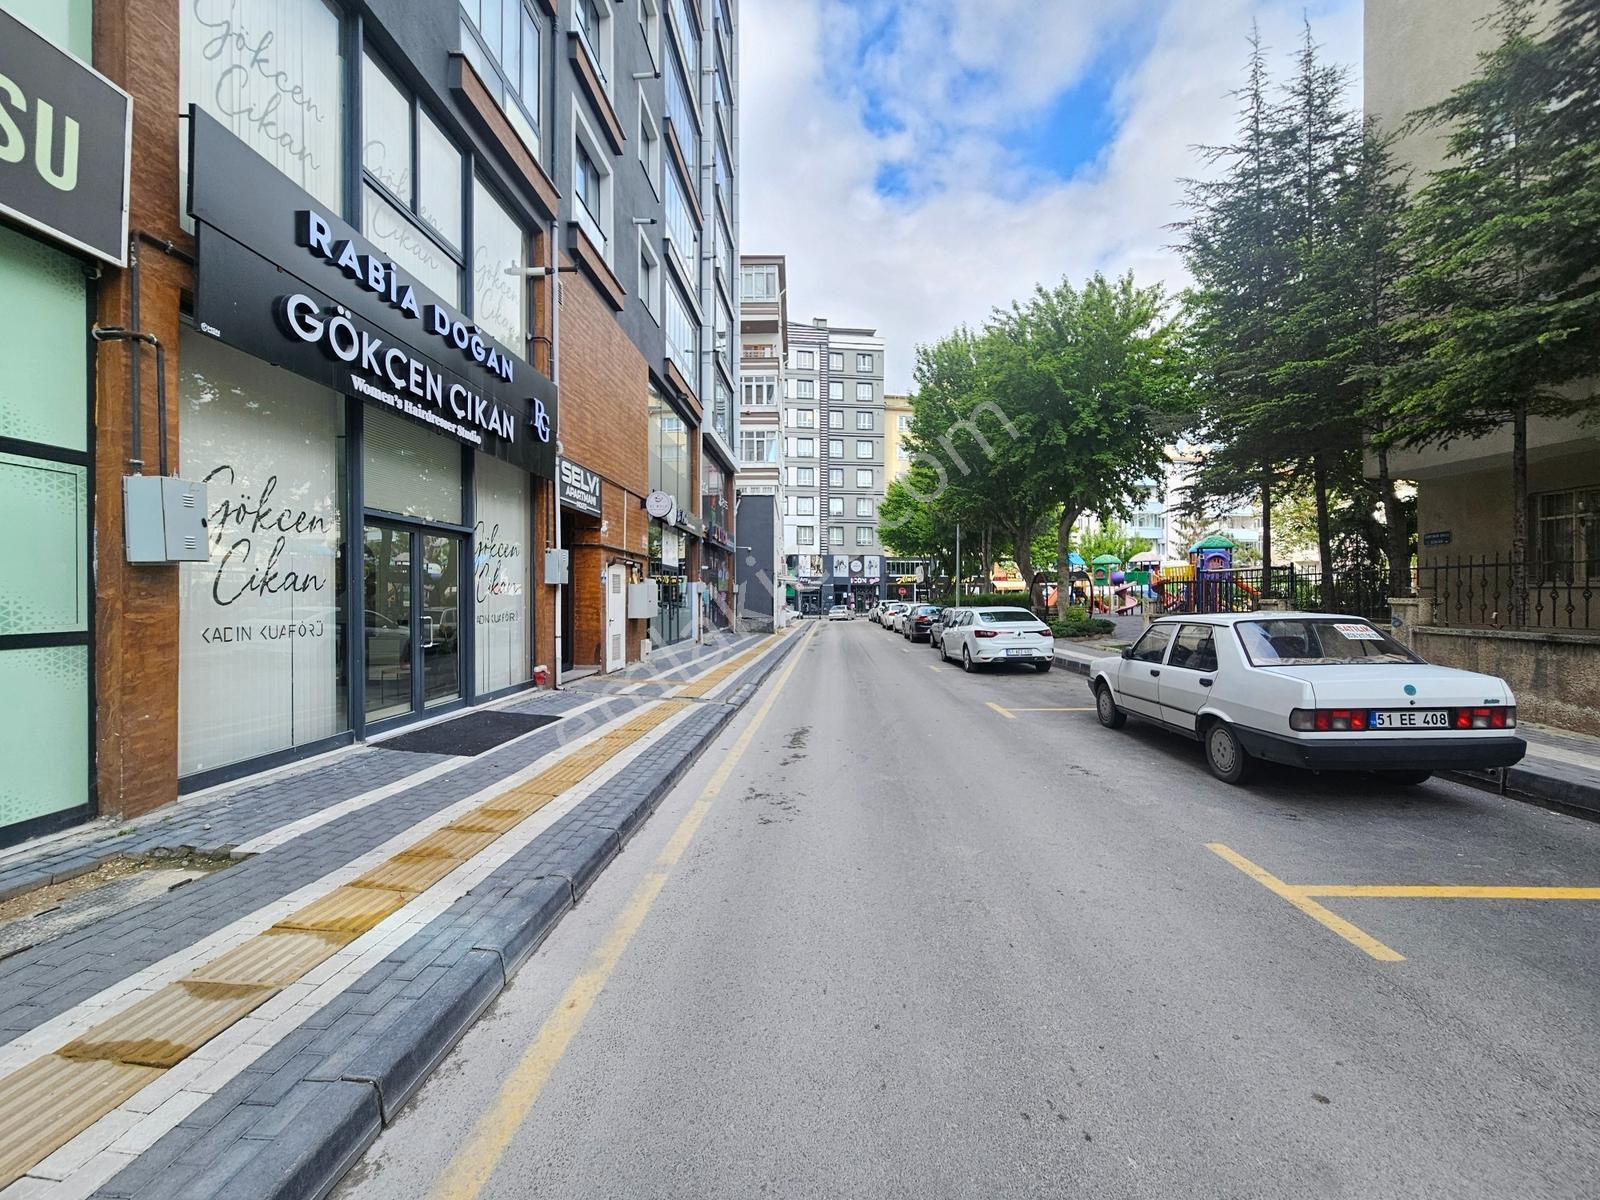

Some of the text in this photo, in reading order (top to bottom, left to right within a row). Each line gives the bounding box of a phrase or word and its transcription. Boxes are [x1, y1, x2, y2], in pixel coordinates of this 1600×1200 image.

[286, 293, 515, 443] GÖKÇEN ÇIKAN
[308, 209, 514, 383] RABİA DOĞAN
[1377, 713, 1447, 726] 51 EE 408
